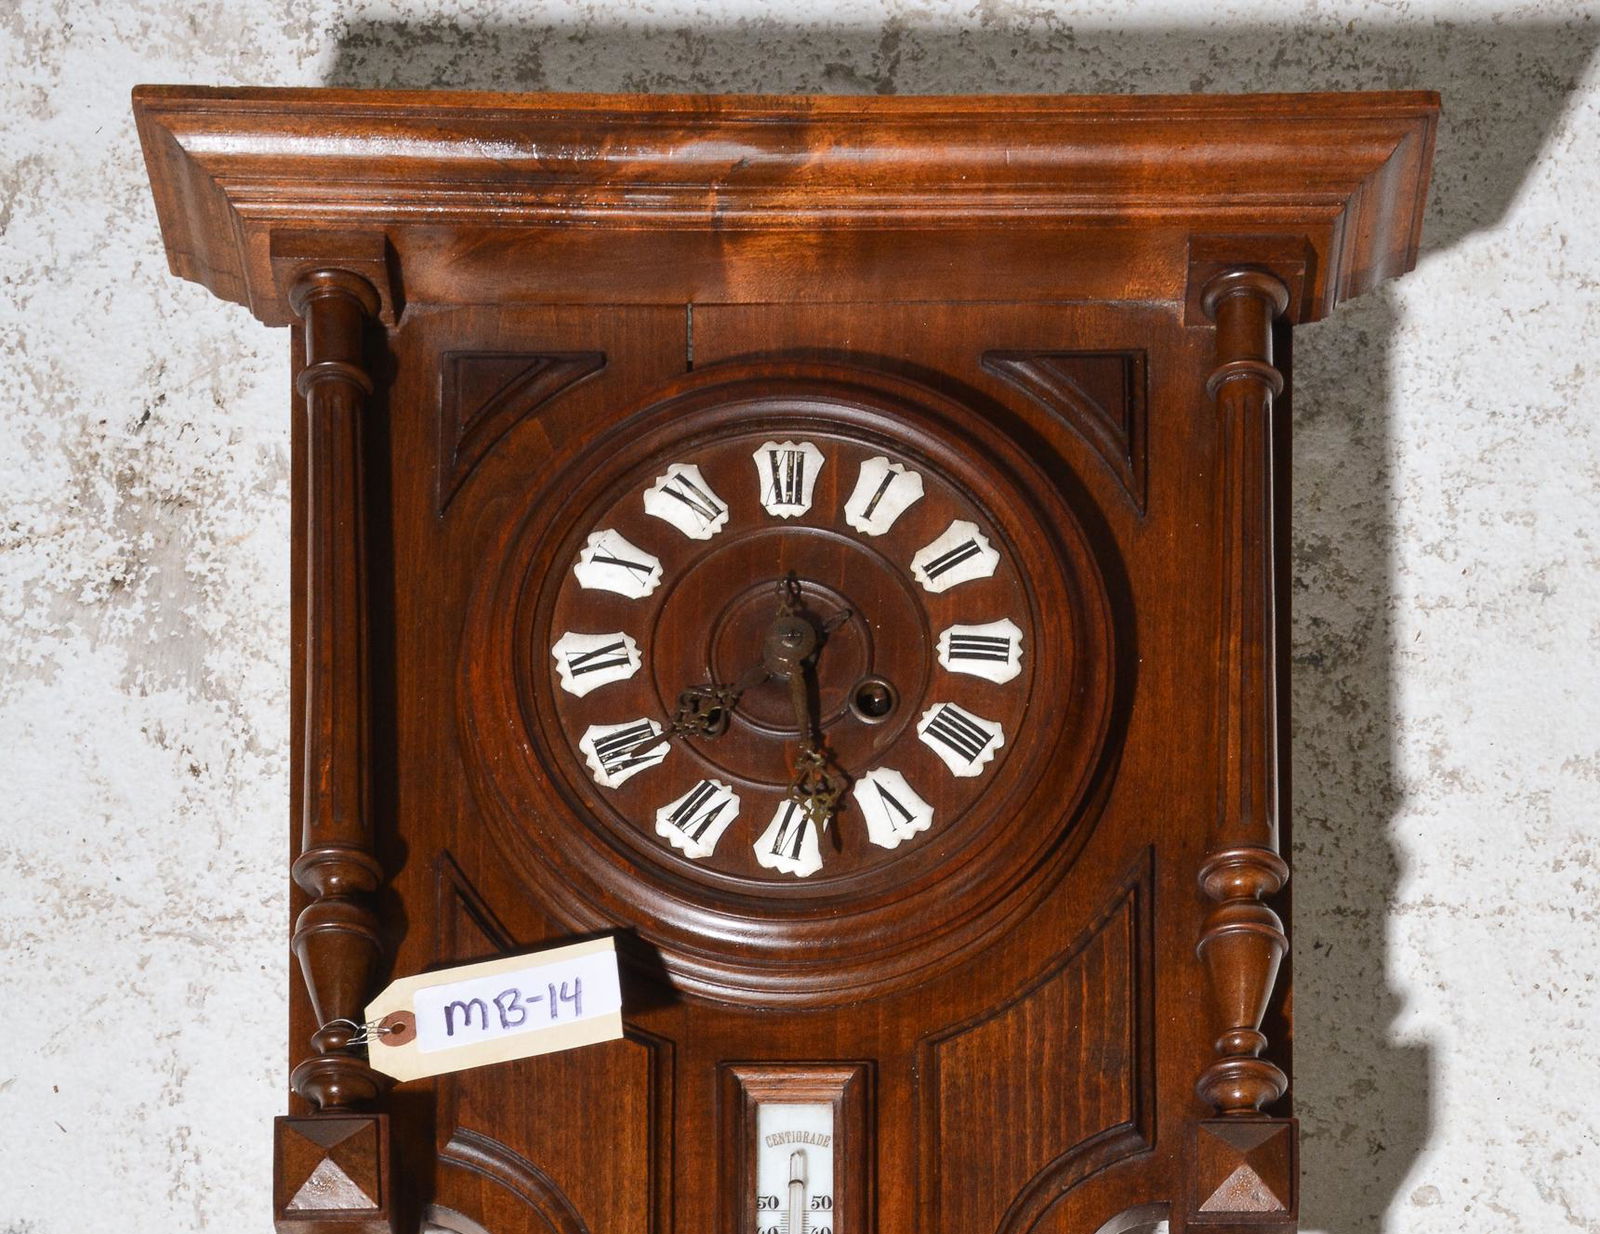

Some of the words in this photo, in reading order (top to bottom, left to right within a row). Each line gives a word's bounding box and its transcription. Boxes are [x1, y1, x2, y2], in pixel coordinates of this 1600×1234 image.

[660, 472, 724, 532] XI
[766, 450, 806, 507] XII
[861, 469, 900, 522] I
[590, 539, 655, 587] X
[922, 538, 984, 584] II
[566, 639, 632, 679] IX
[948, 633, 1011, 664] III
[922, 704, 995, 765] IIII
[666, 779, 732, 845] VII
[872, 778, 917, 832] V
[765, 1131, 831, 1148] CENTIGRADE
[757, 1195, 780, 1210] 50
[811, 1195, 833, 1210] 50
